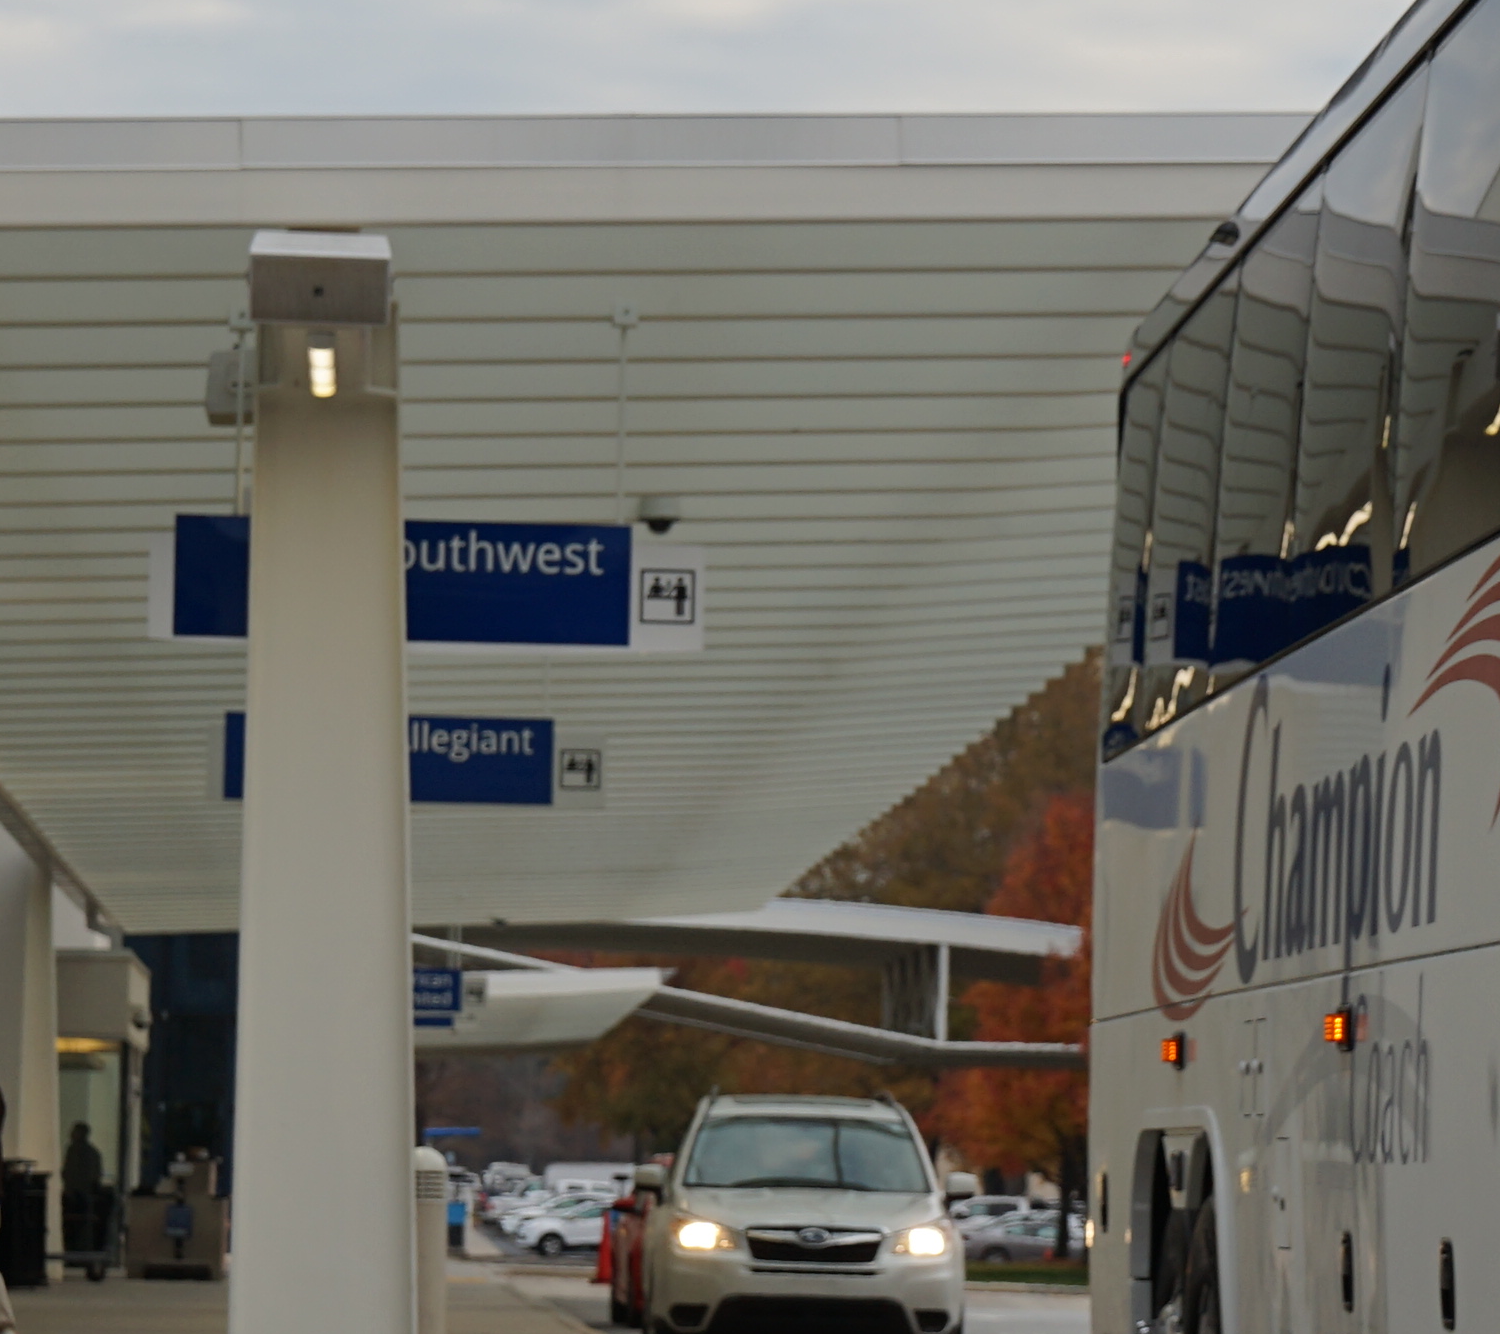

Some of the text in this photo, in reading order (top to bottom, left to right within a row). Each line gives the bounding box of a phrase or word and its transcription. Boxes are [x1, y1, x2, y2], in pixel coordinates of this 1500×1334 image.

[404, 528, 605, 576] uthwest
[410, 719, 536, 763] llegiant
[1234, 664, 1442, 1005] Champion
[1351, 971, 1429, 1165] Coach
